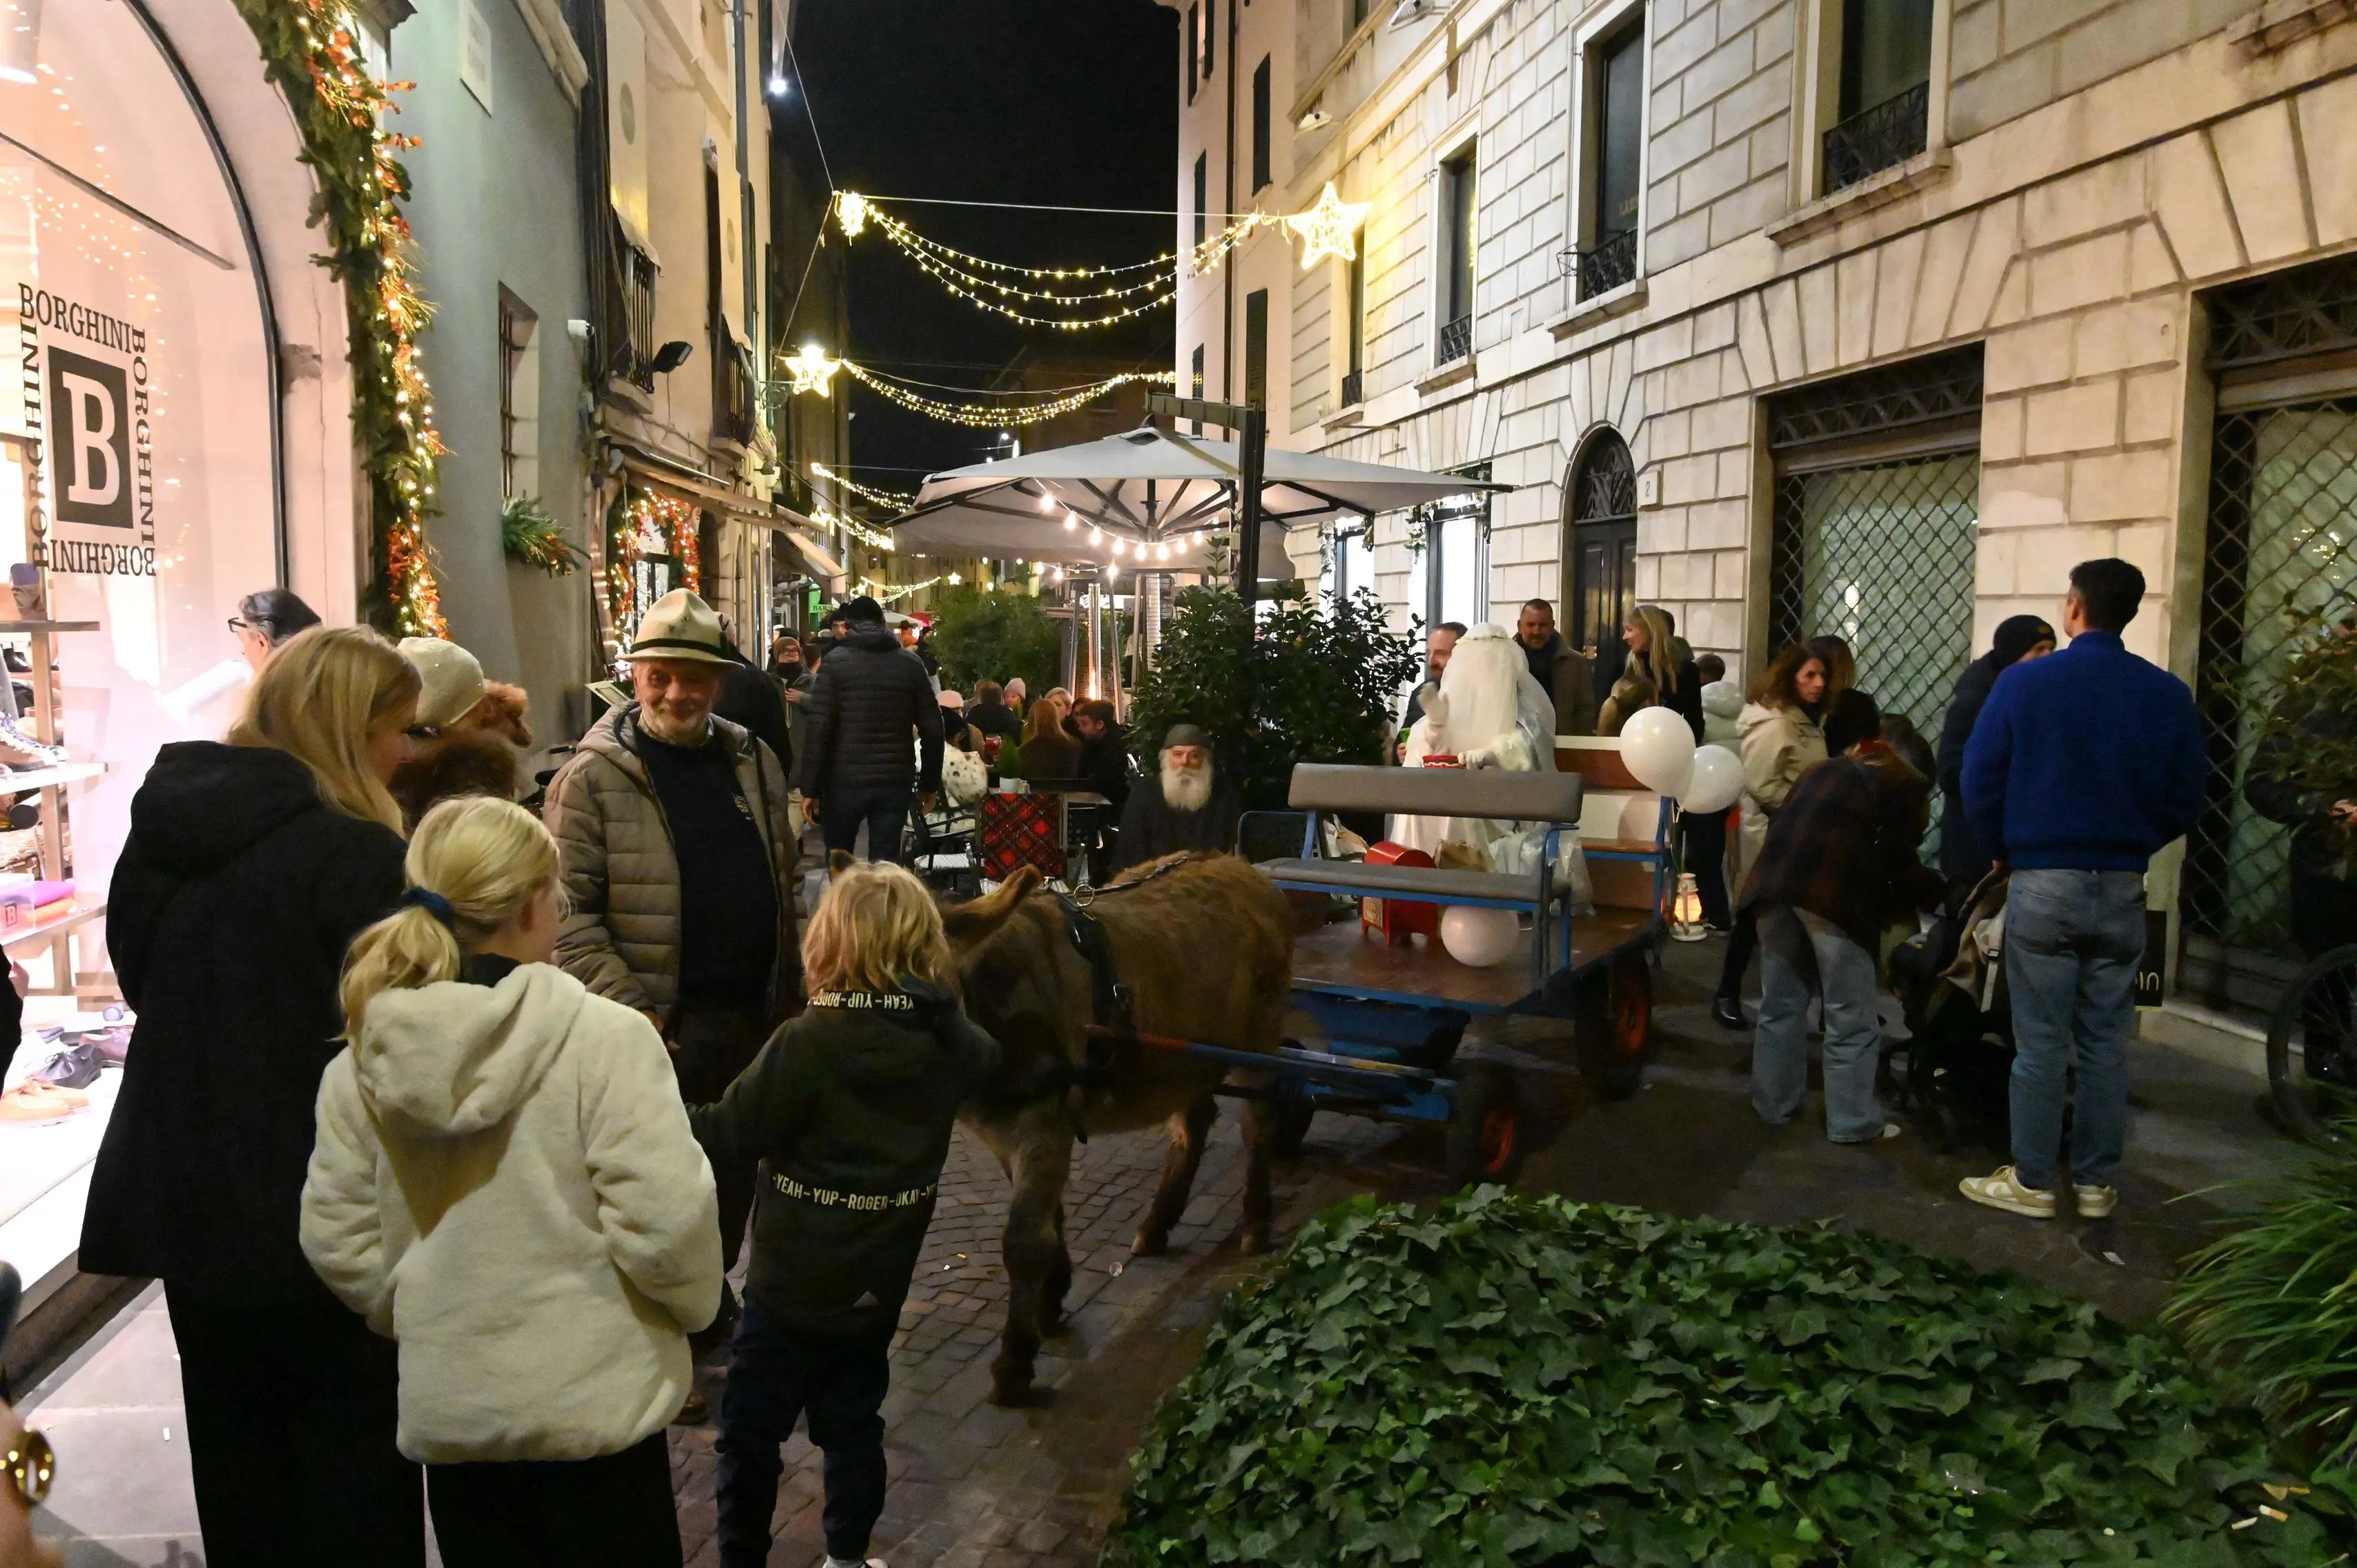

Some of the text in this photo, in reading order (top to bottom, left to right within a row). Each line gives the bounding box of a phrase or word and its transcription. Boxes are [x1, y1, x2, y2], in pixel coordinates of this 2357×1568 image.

[19, 283, 131, 354] BORGHINI
[63, 371, 120, 506] B
[131, 325, 155, 545] BORGHINI
[50, 539, 156, 577] BORGHINI
